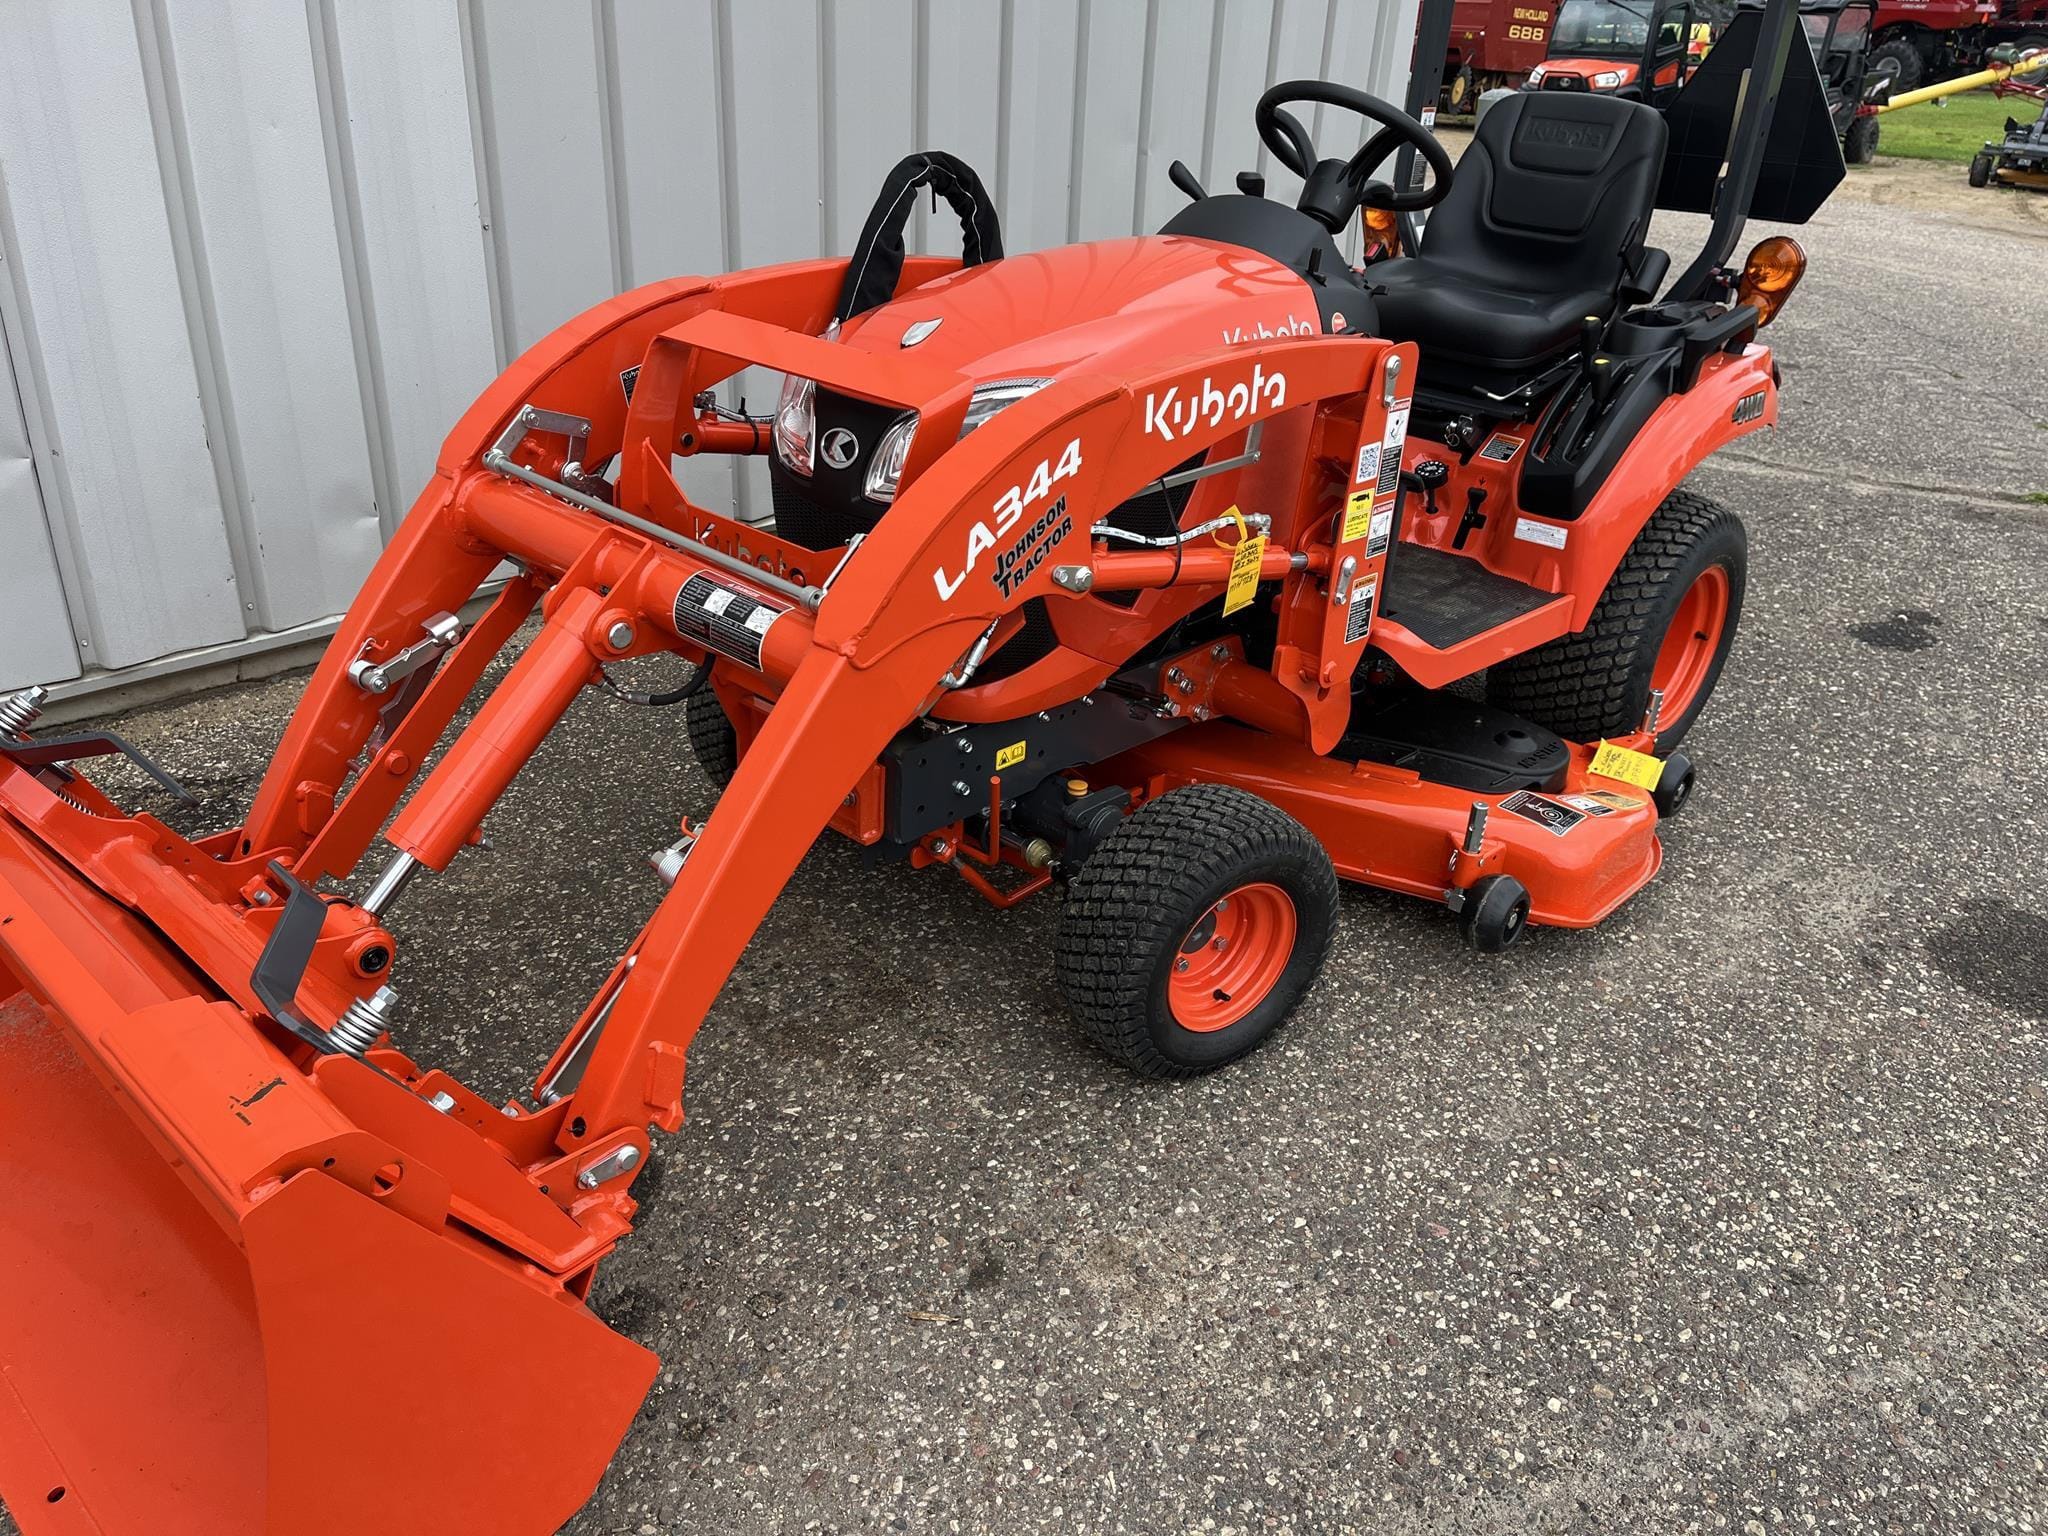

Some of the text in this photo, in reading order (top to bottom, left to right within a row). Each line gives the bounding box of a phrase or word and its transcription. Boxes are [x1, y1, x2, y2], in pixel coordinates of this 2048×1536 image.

[1508, 25, 1544, 41] 688
[1144, 363, 1286, 442] Kubota
[932, 437, 1083, 601] LA344
[991, 491, 1068, 584] JOHNSON
[998, 516, 1074, 602] TRACTOR
